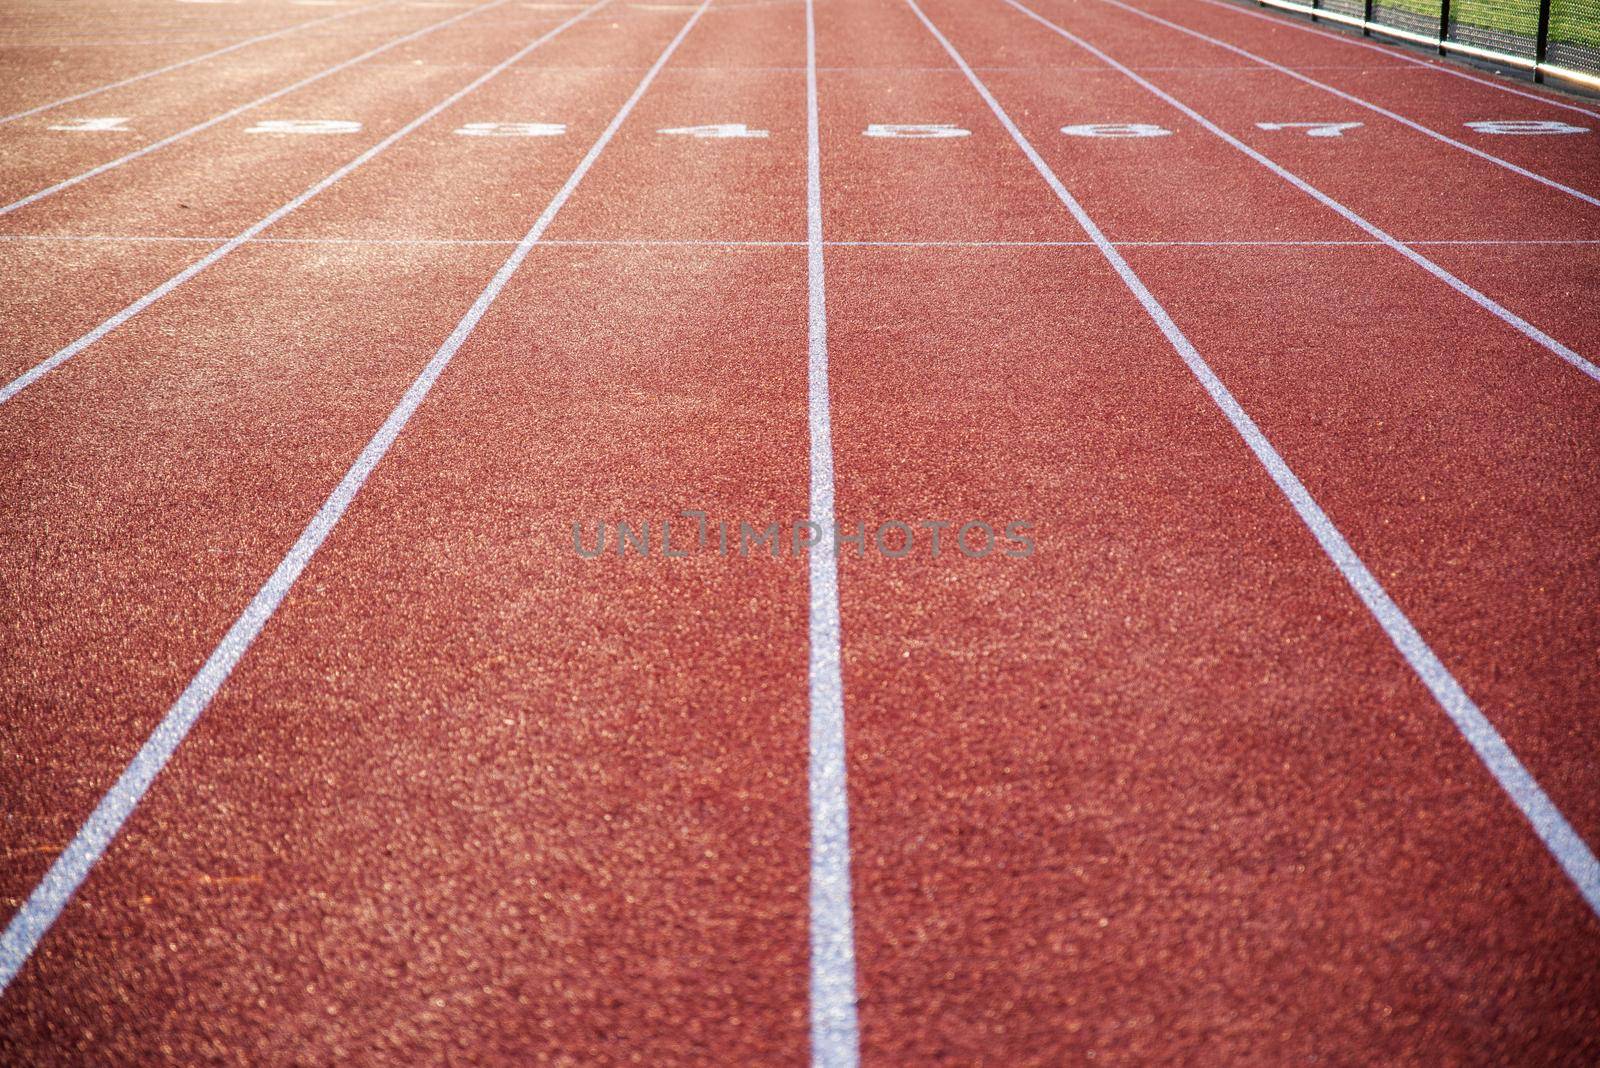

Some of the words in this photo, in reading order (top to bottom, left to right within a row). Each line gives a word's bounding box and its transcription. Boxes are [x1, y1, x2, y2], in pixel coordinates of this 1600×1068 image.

[48, 117, 130, 133] 1
[244, 119, 362, 134] 2
[453, 122, 566, 136] 3
[657, 124, 770, 138] 4
[862, 124, 972, 138] 5
[1061, 123, 1172, 137] 6
[1255, 122, 1365, 137] 7
[1463, 120, 1590, 136] 8
